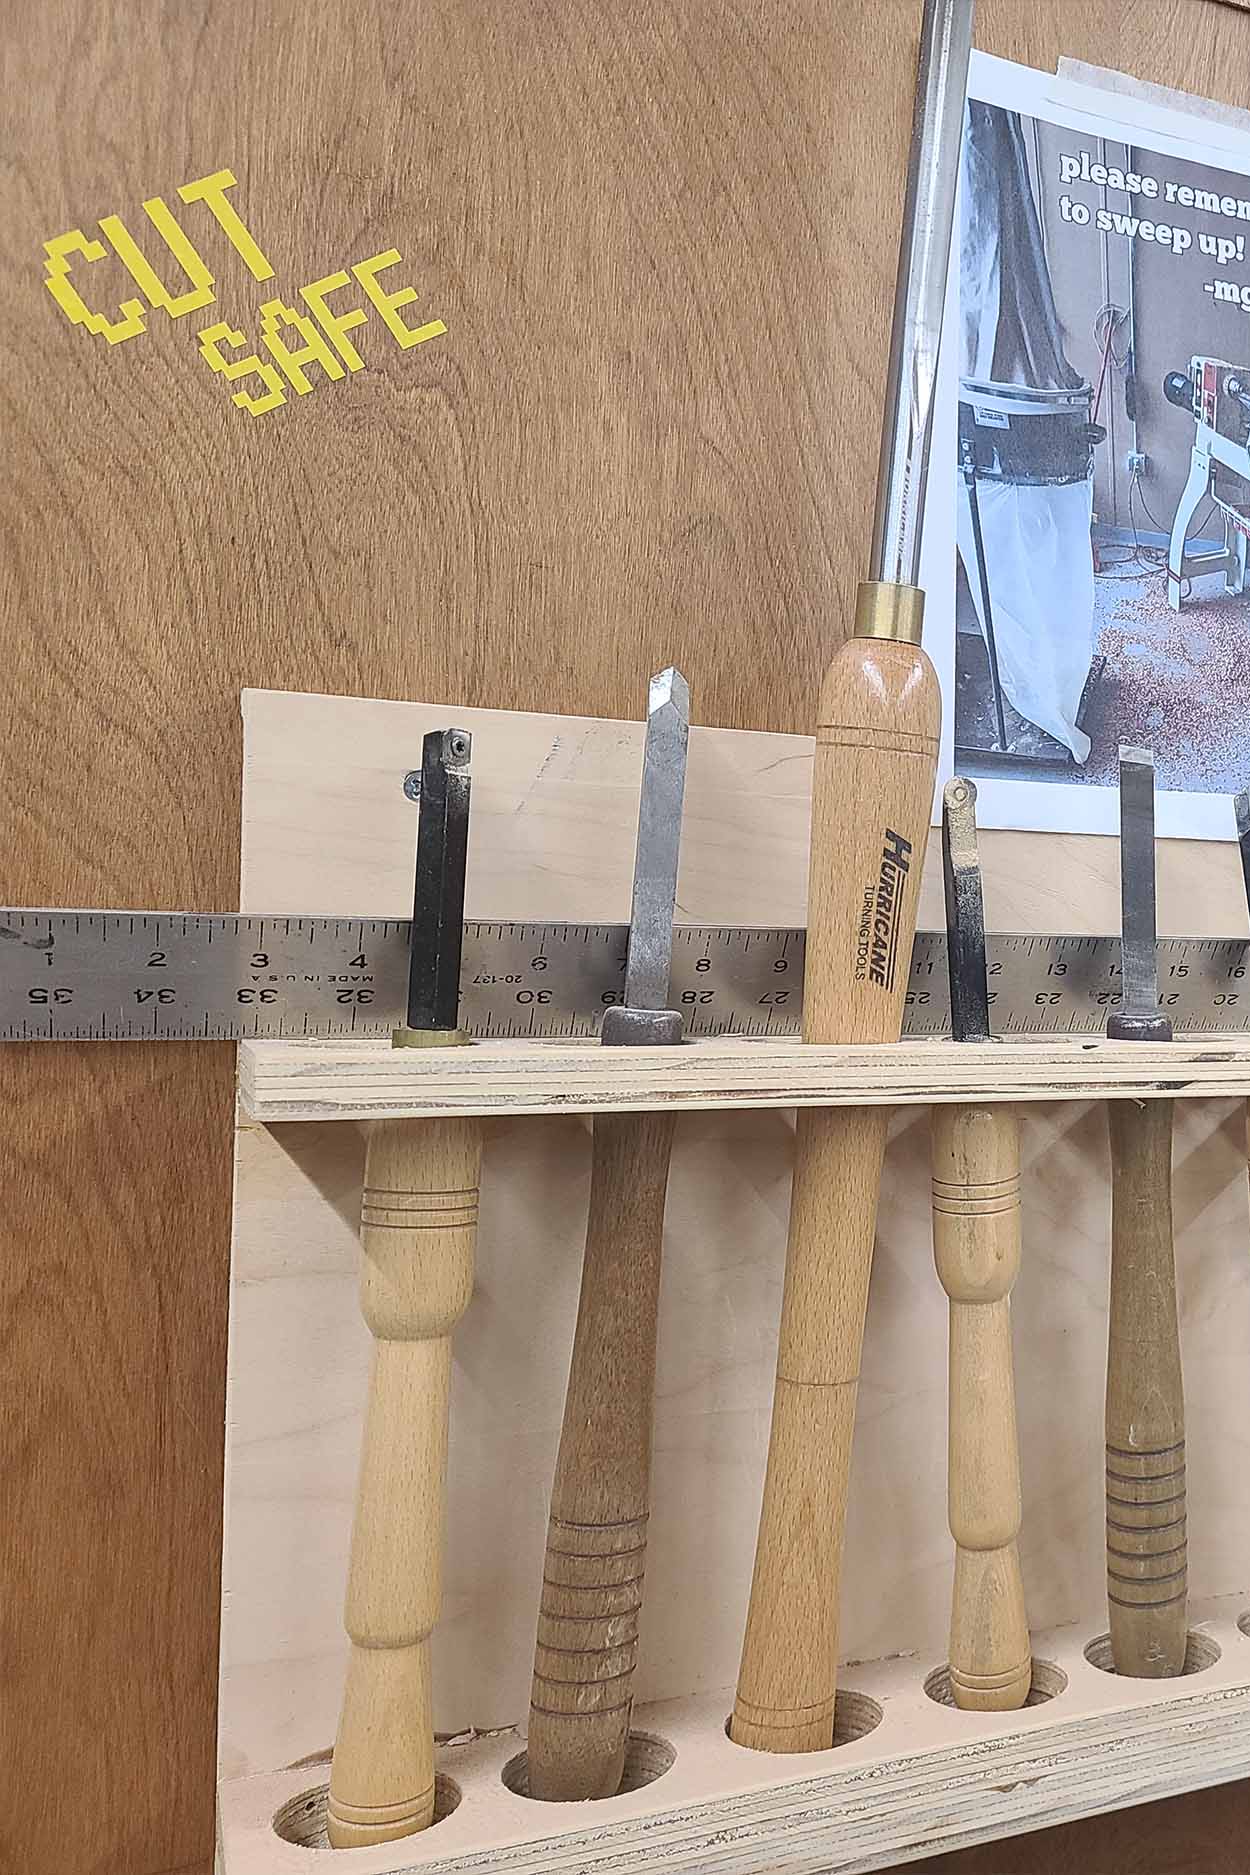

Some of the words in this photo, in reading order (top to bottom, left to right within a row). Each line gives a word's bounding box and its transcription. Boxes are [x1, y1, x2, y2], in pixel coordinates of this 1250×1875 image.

[1059, 151, 1158, 199] please
[1059, 195, 1090, 226] to
[1096, 208, 1192, 254] sweep
[1198, 232, 1245, 265] up!
[43, 168, 275, 345] CUT
[197, 248, 448, 417] SAFE
[859, 885, 875, 938] TURNING
[45, 952, 53, 966] 1
[147, 952, 167, 967] 2
[250, 953, 269, 968] 3
[349, 953, 368, 969] 4
[531, 956, 548, 971] 6
[696, 958, 711, 972] 8
[774, 959, 788, 973] 9
[915, 961, 933, 975] 11
[1048, 963, 1067, 976] 13
[1169, 965, 1189, 978] 15
[1227, 966, 1245, 978] 16
[855, 941, 870, 981] TOOLS
[473, 975, 522, 984] 20-137
[28, 988, 73, 1004] 35
[134, 988, 176, 1004] 34
[236, 988, 278, 1004] 33
[336, 988, 375, 1004] 32
[516, 990, 552, 1004] 30
[681, 990, 714, 1004] 28
[758, 991, 790, 1004] 27
[904, 991, 931, 1004] 25
[1034, 992, 1063, 1005] 23
[1096, 993, 1123, 1005] 22
[1157, 993, 1180, 1005] 21
